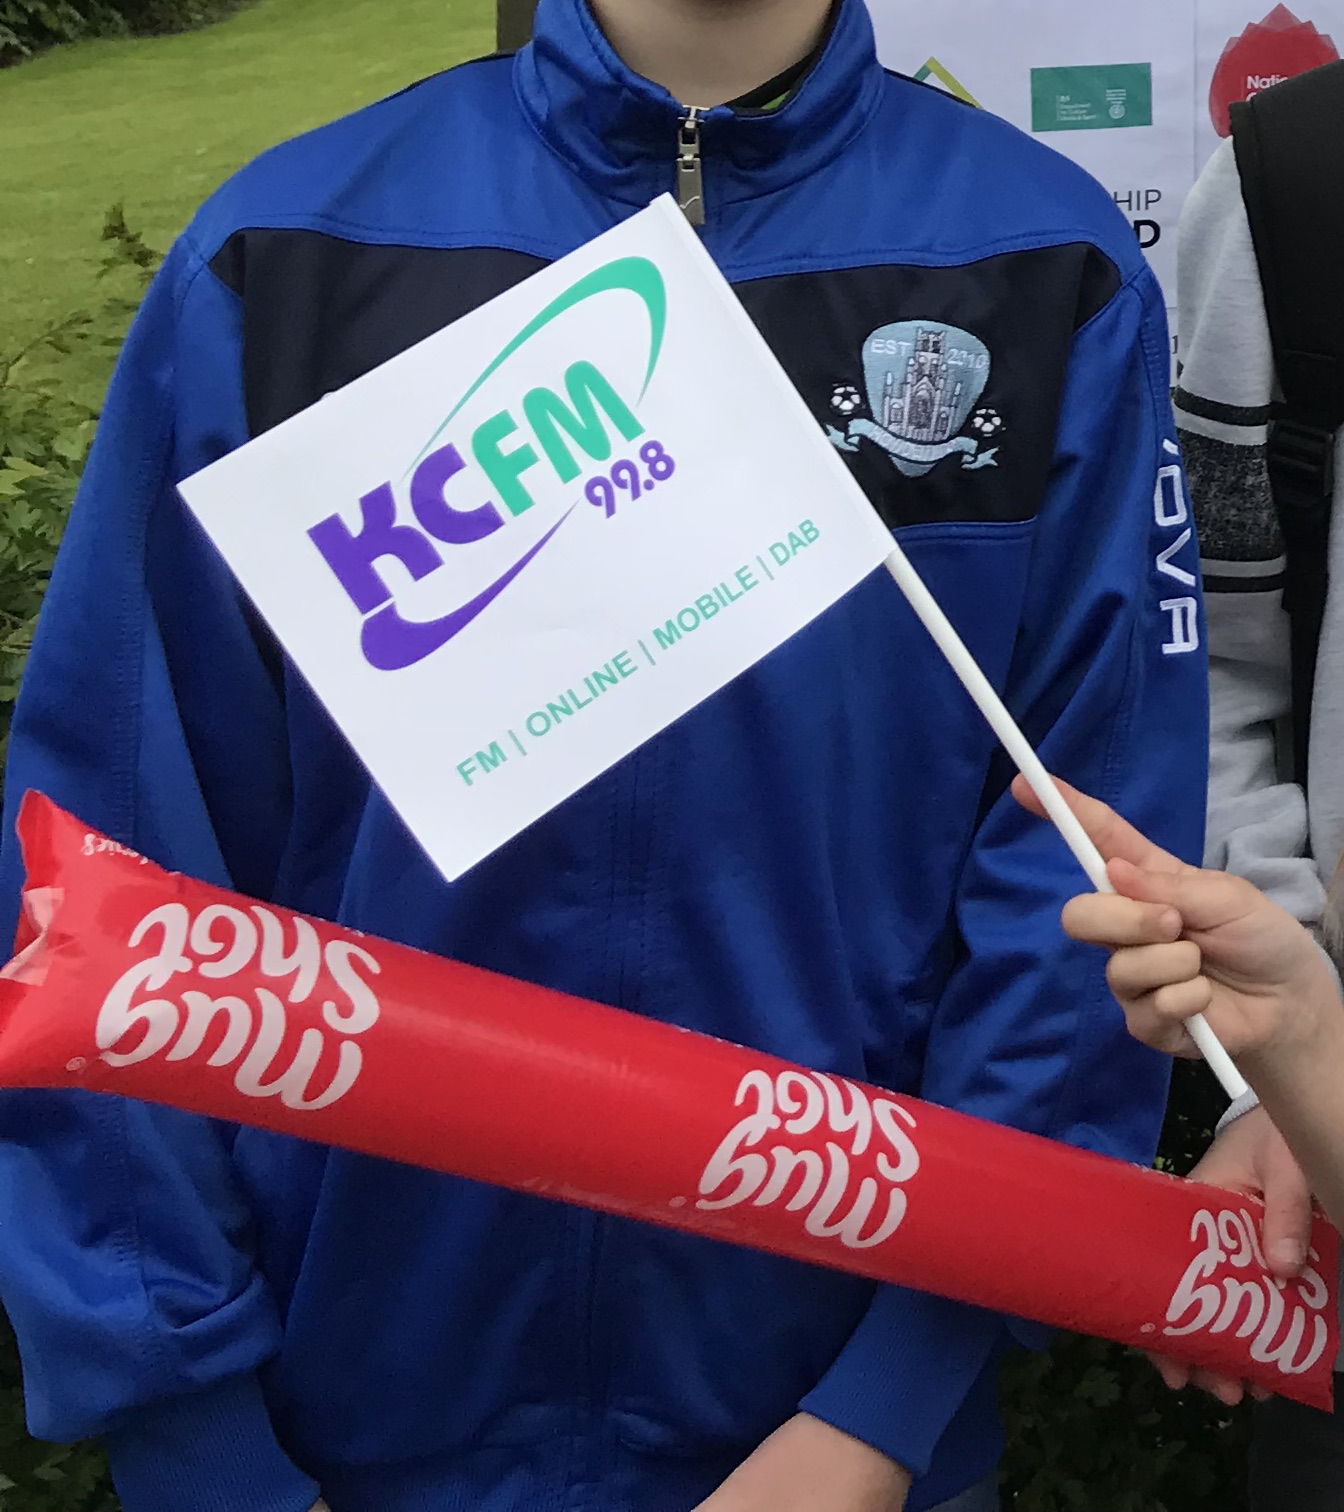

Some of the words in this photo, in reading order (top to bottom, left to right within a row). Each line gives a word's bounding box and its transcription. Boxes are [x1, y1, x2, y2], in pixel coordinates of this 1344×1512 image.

[869, 338, 913, 357] EST
[306, 359, 646, 617] KCFM
[583, 439, 677, 519] 99.8
[455, 740, 507, 787] FM
[525, 639, 640, 738] ONLINE
[652, 565, 760, 652] MOBILE
[768, 517, 822, 568] DAB
